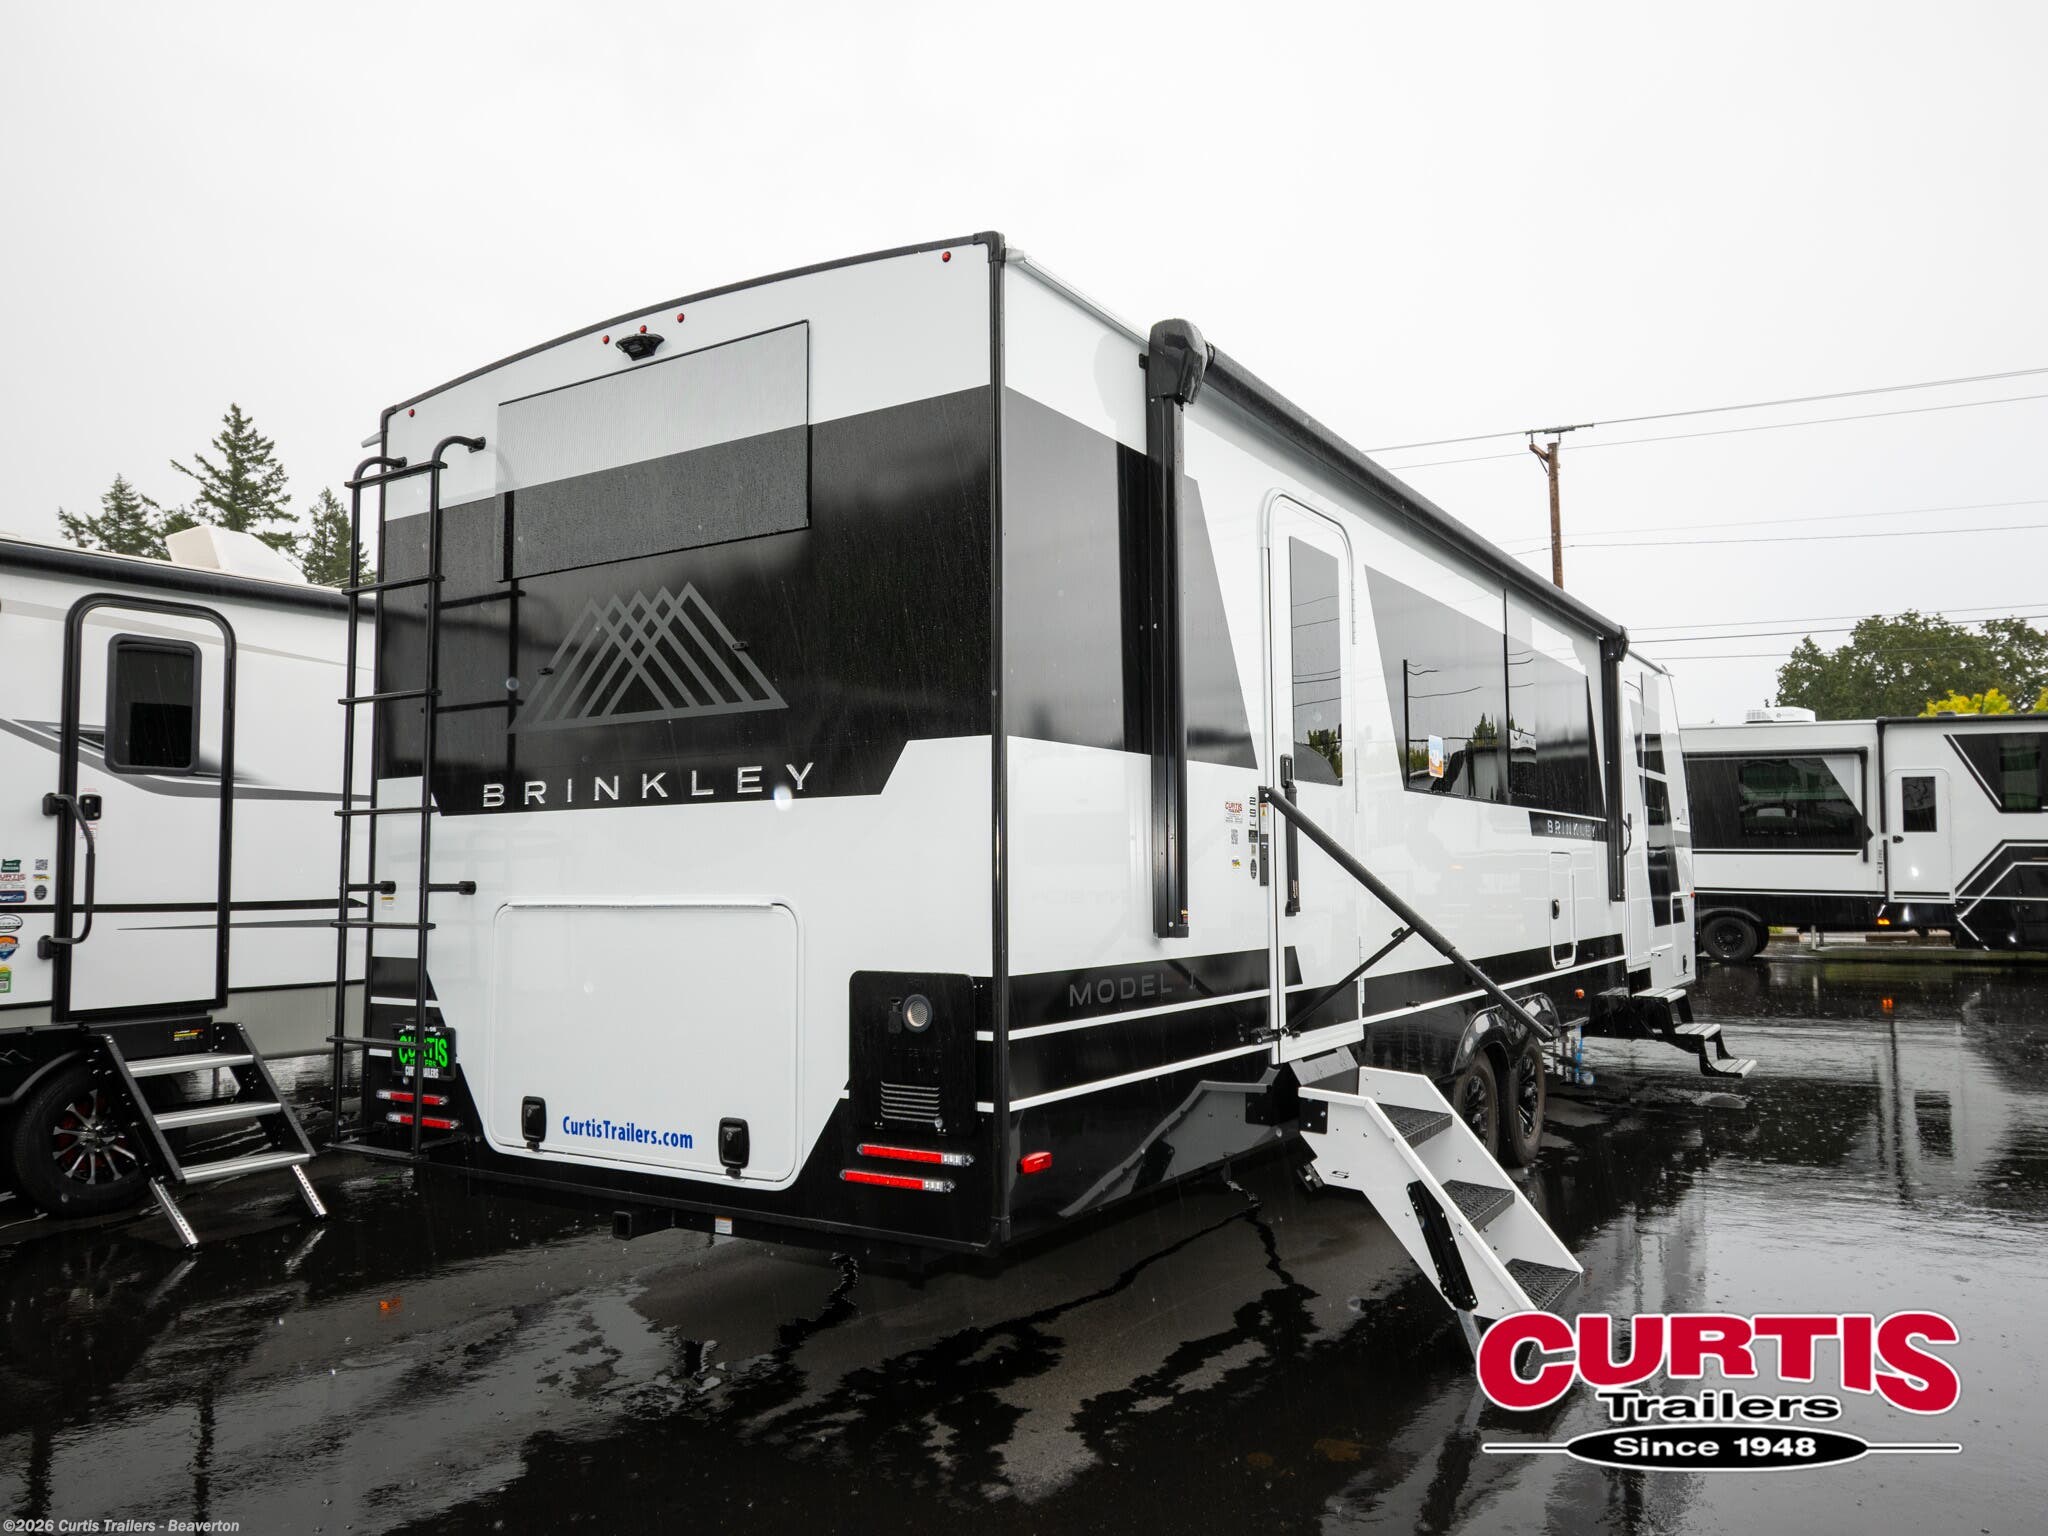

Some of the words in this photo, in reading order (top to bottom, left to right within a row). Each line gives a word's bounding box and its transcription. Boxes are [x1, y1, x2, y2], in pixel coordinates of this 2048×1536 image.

[482, 762, 814, 807] BRINKLEY
[1547, 819, 1596, 838] BRINKLEY
[1069, 973, 1173, 1007] MODEL
[398, 1035, 448, 1067] CUTIS
[562, 1115, 693, 1149] CurtisTrailers.com
